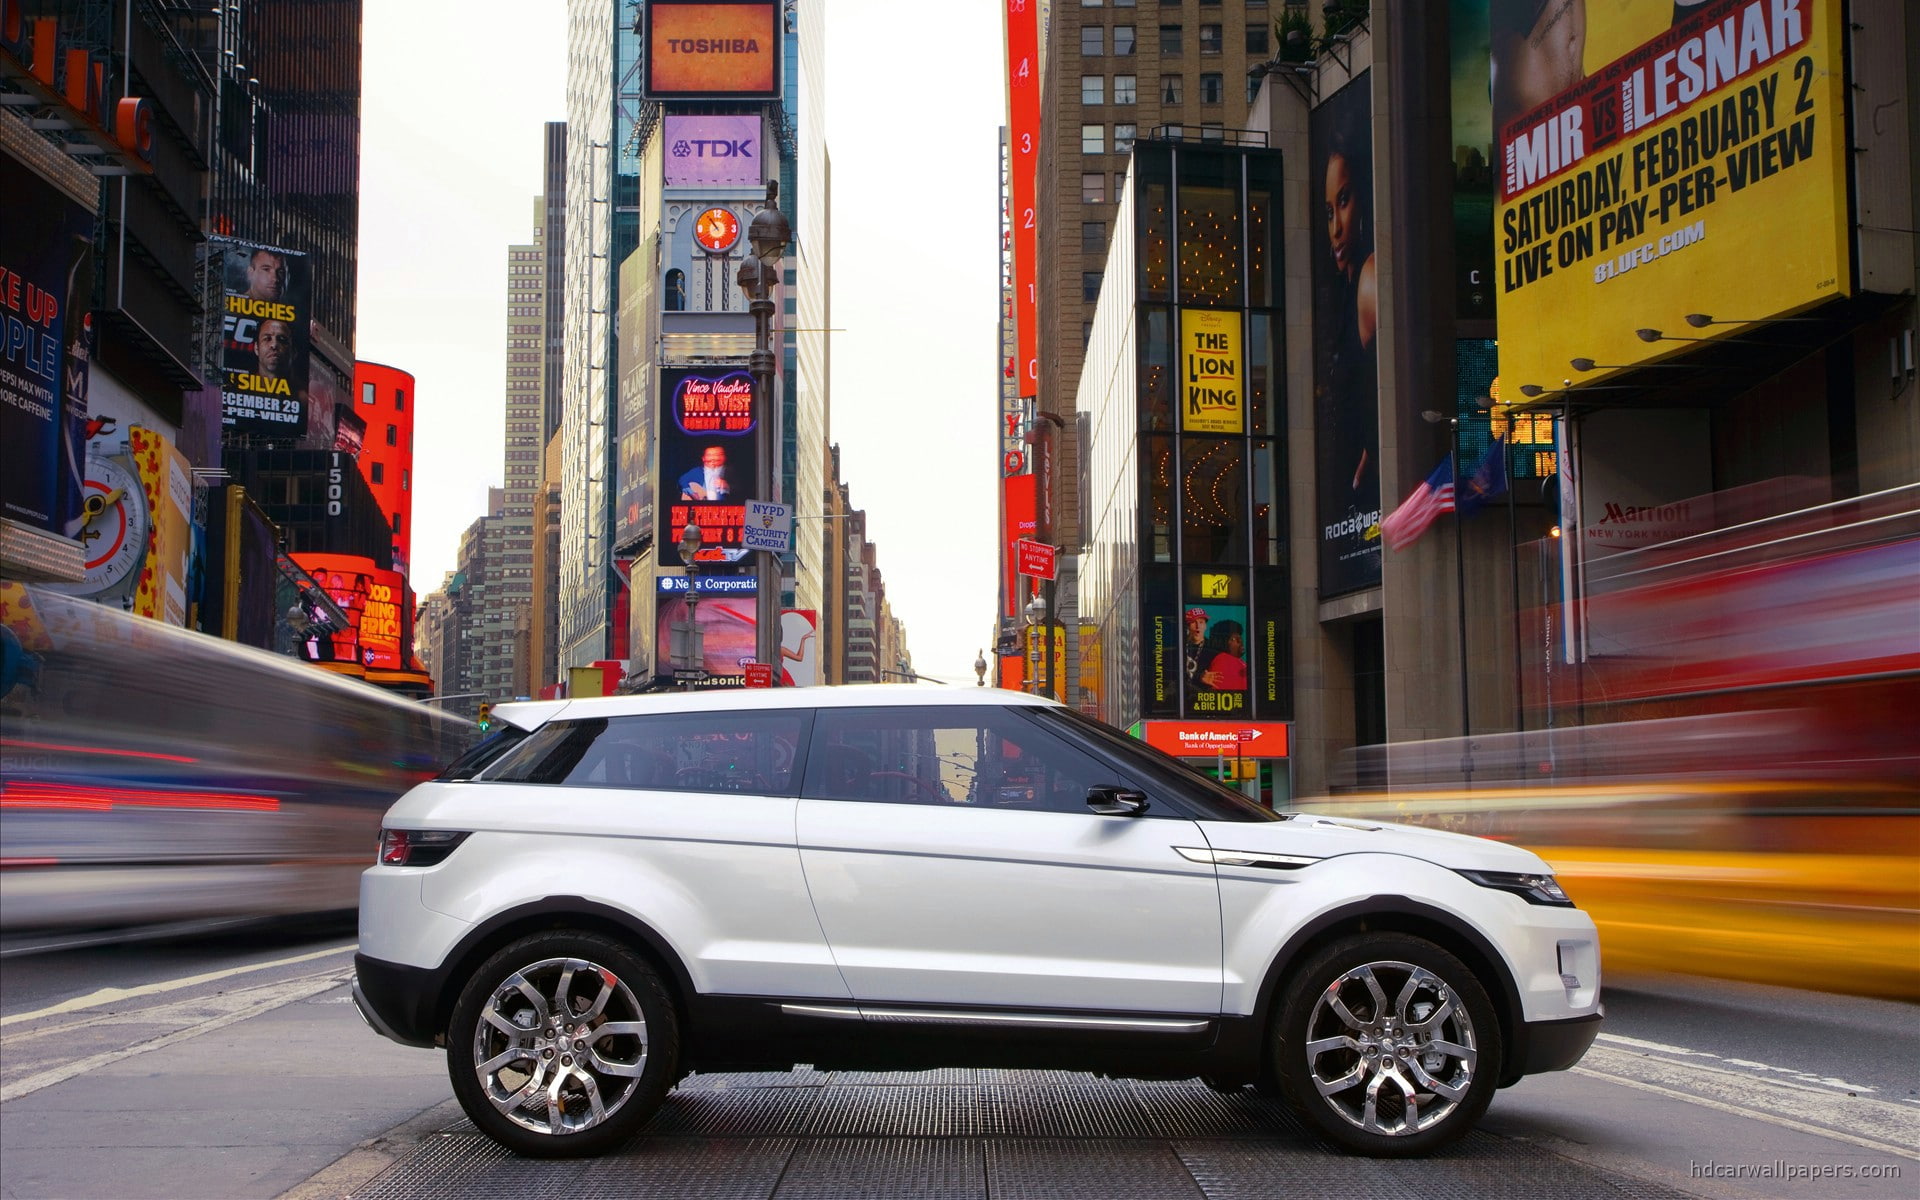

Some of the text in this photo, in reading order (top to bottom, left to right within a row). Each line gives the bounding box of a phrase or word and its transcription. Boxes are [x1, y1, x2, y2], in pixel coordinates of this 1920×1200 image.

[668, 39, 759, 54] TOSHIBA
[1019, 57, 1029, 78] 4
[1506, 103, 1554, 138] FORMER
[1555, 80, 1602, 109] CHAMP
[1623, 13, 1704, 70] WRESTLING
[1623, 77, 1633, 134] BROCK
[1633, 0, 1803, 130] LESNAR
[1592, 97, 1617, 136] VS
[691, 140, 752, 157] TDK
[1021, 133, 1031, 153] 3
[1506, 105, 1584, 195] FRANK MIR
[1503, 56, 1814, 254] SATURDAY, FEBRUARY 2
[1504, 114, 1815, 294] LIVE ON PAY-PER-VIEW
[713, 209, 722, 218] 12
[1023, 208, 1035, 228] 2
[731, 224, 737, 233] 3
[1594, 220, 1705, 285] 81.UFC.COM
[1028, 283, 1034, 304] 1
[26, 282, 58, 328] UP
[230, 296, 296, 322] HUGHES
[1200, 312, 1222, 323] Disney
[1195, 332, 1228, 350] THE
[1189, 354, 1234, 382] LION
[18, 377, 34, 395] MAX
[34, 385, 54, 404] WITH
[237, 373, 291, 396] SILVA
[622, 361, 650, 402] PLANET
[685, 379, 751, 399] Vince Vaughn's
[282, 400, 300, 414] 29
[628, 390, 648, 416] PERIL
[683, 393, 751, 412] WILD WEST
[1189, 386, 1237, 415] KING
[106, 474, 110, 483] 1
[328, 452, 342, 516] 1500
[123, 491, 129, 500] 2
[753, 504, 785, 516] NYPD
[1599, 502, 1691, 525] Marriott
[128, 518, 134, 527] 3
[745, 525, 789, 539] SECURITY
[1588, 529, 1614, 538] NEW
[1619, 529, 1648, 538] YORK
[122, 544, 128, 553] 4
[746, 535, 786, 548] CAMERA
[1020, 543, 1028, 551] NO
[1029, 544, 1053, 556] STOPPING
[1024, 553, 1049, 564] ANYTIME
[107, 565, 113, 573] 5
[675, 578, 701, 589] Nes
[1197, 692, 1215, 702] ROB
[1217, 693, 1233, 711] 10
[1234, 701, 1243, 709] PM
[1179, 731, 1199, 740] Bank
[1200, 731, 1209, 740] of
[1209, 731, 1239, 741] Americ
[1205, 742, 1237, 750] Opportunity
